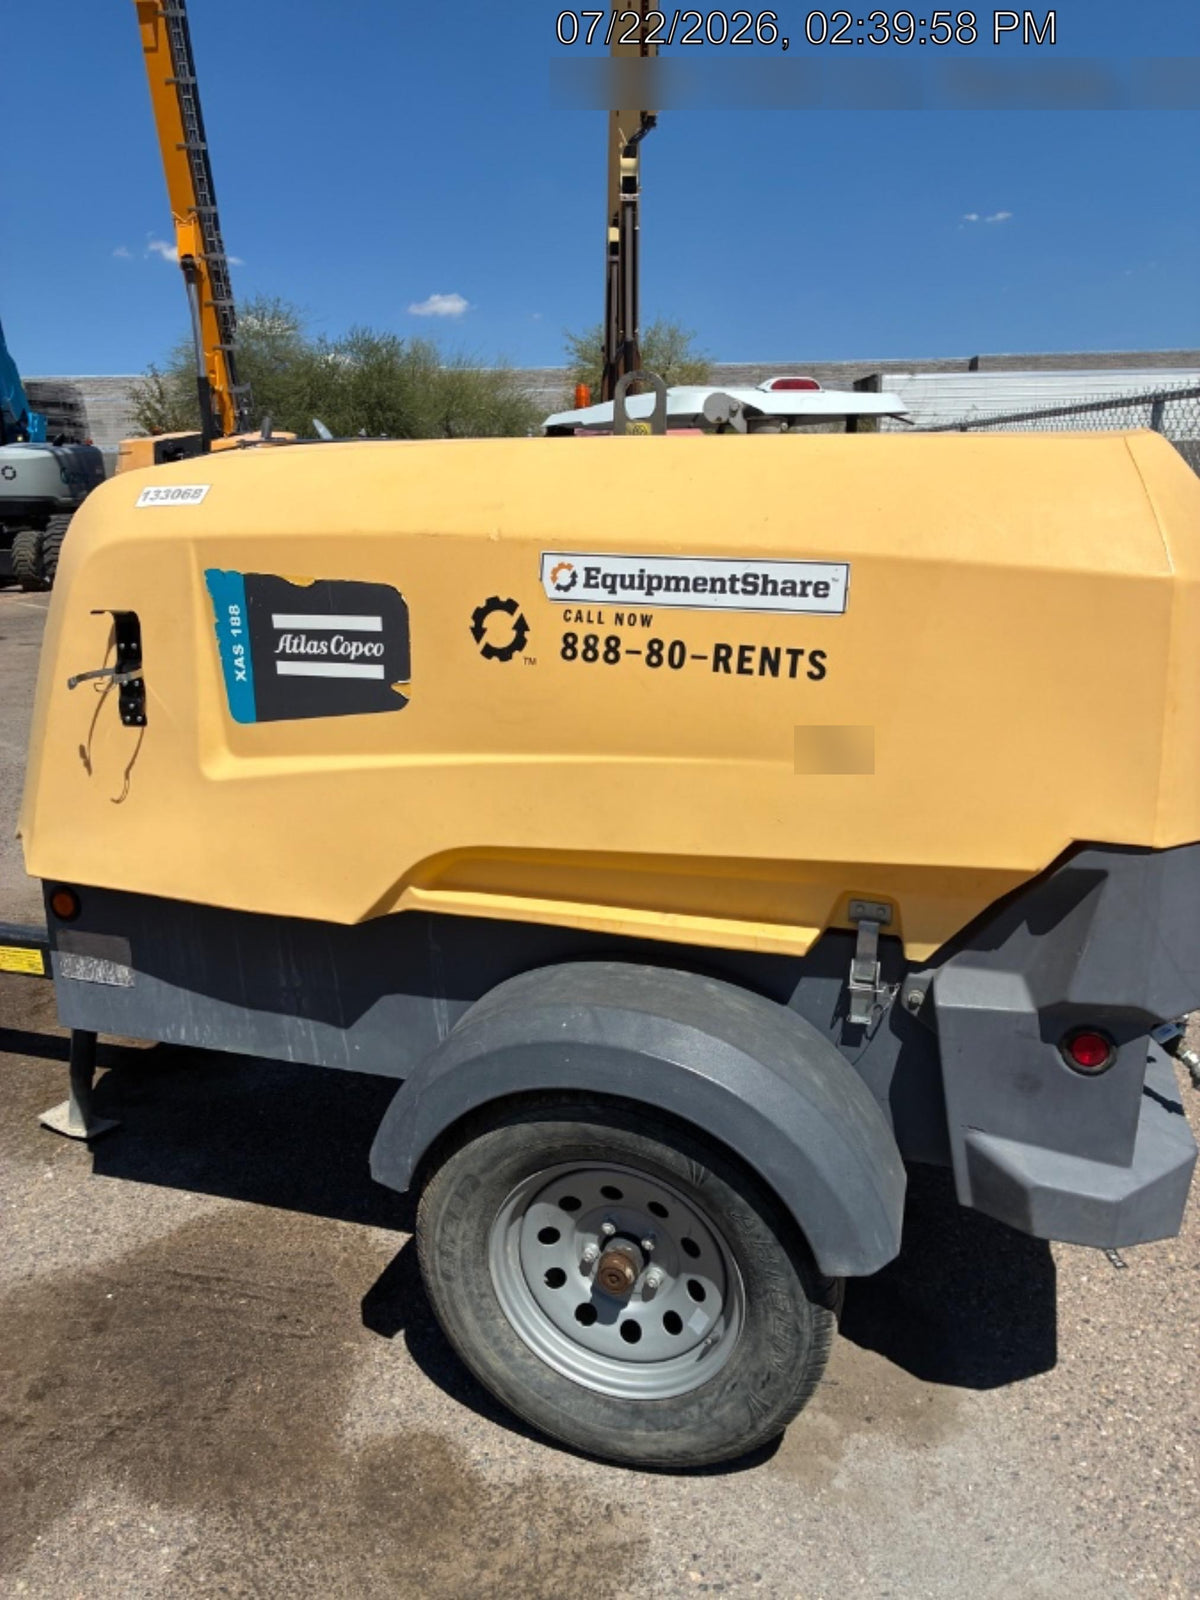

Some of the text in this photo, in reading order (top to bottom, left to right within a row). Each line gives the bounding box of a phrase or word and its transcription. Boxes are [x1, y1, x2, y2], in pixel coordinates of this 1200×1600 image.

[142, 488, 203, 502] 133068
[582, 566, 831, 598] EquipmentShare
[562, 609, 653, 628] CALL NOW
[229, 604, 247, 682] XAS 188
[274, 634, 385, 660] Atlas Copco
[560, 631, 828, 681] 888-80-RENTS
